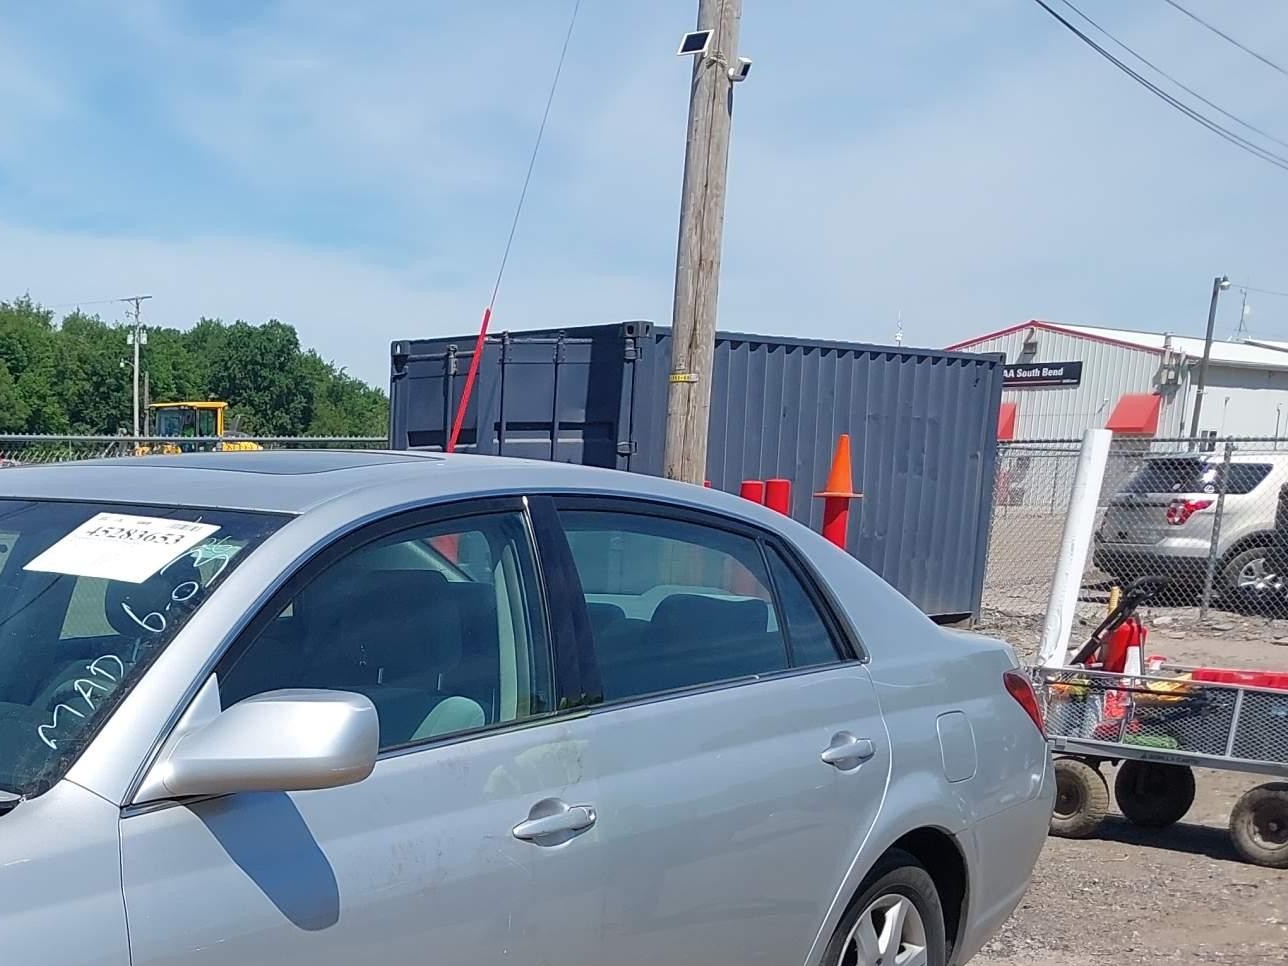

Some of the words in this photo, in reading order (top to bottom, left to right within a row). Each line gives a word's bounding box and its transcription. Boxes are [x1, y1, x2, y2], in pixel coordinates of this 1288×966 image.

[1016, 368, 1040, 378] South
[1042, 367, 1064, 377] Bend
[85, 526, 185, 545] 45283653
